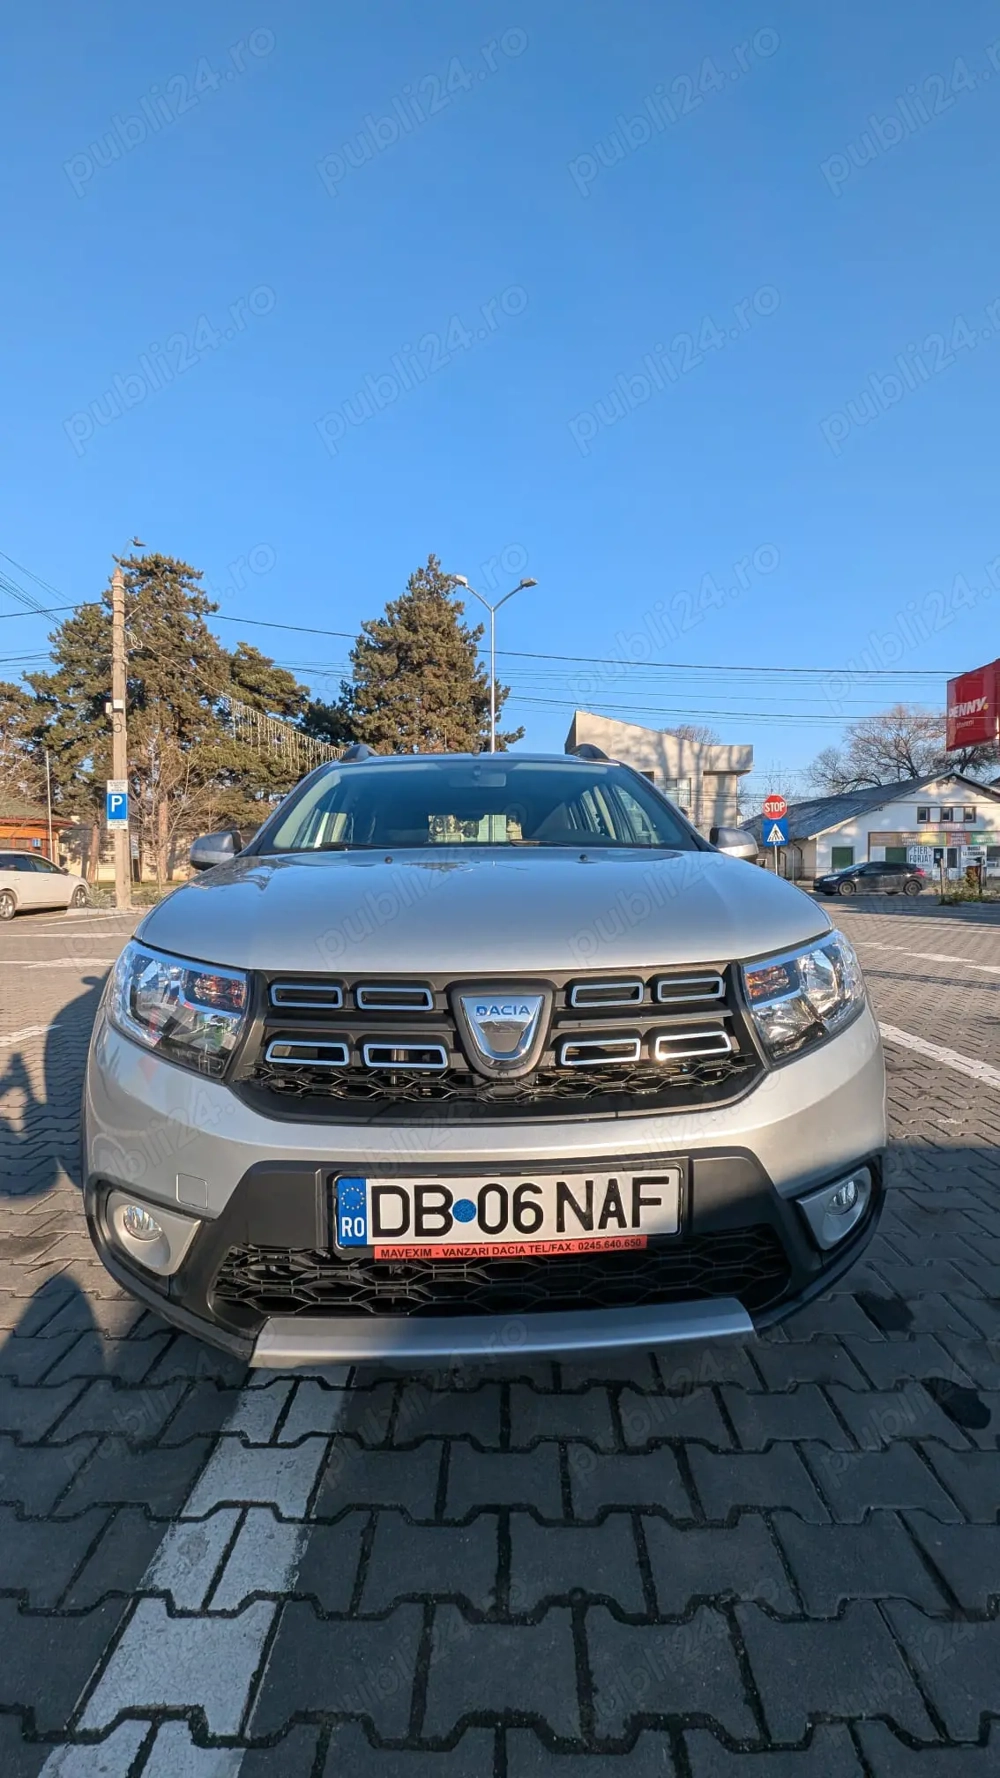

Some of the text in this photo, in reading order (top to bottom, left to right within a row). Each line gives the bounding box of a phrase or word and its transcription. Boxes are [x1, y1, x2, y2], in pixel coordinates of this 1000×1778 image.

[111, 795, 123, 813] P
[764, 802, 785, 812] STOP
[913, 846, 928, 854] FIER
[909, 854, 931, 863] FORJAT
[475, 1004, 531, 1017] DACIA
[371, 1176, 670, 1238] DB 06 NAF
[341, 1217, 365, 1238] RO
[380, 1248, 432, 1258] MAVEXIM
[442, 1246, 489, 1256] VANZARI
[492, 1245, 526, 1255] DACIA
[529, 1243, 575, 1254] TEL/FAX:
[578, 1238, 642, 1251] 0245.640.650
